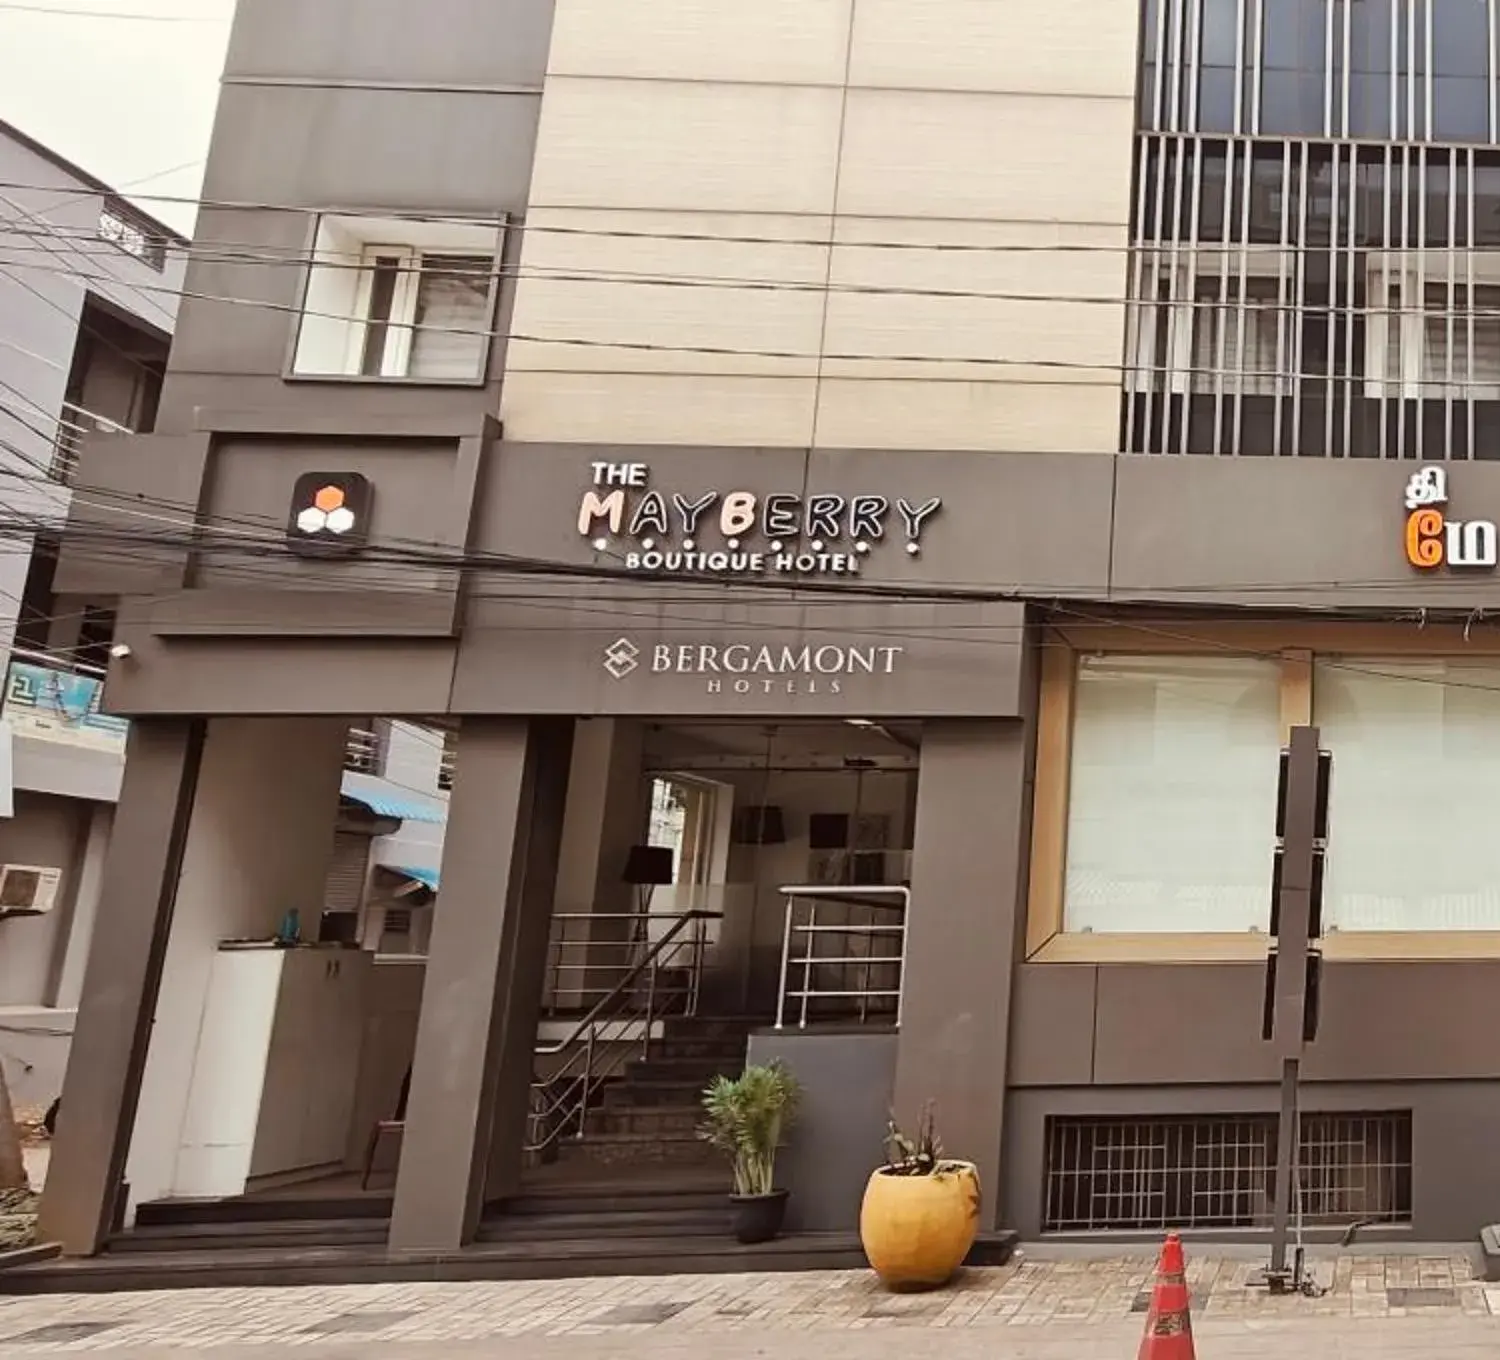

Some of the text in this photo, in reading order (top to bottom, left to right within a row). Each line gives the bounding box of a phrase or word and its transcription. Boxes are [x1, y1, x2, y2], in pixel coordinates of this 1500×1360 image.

[591, 462, 647, 486] THE
[1405, 465, 1448, 508] தி
[577, 490, 942, 538] MAYBERRY
[1405, 509, 1498, 568] மே
[625, 552, 859, 573] BOUTIQUE HOTEL
[651, 645, 903, 674] BERGAMONT
[706, 679, 842, 694] HOTELS
